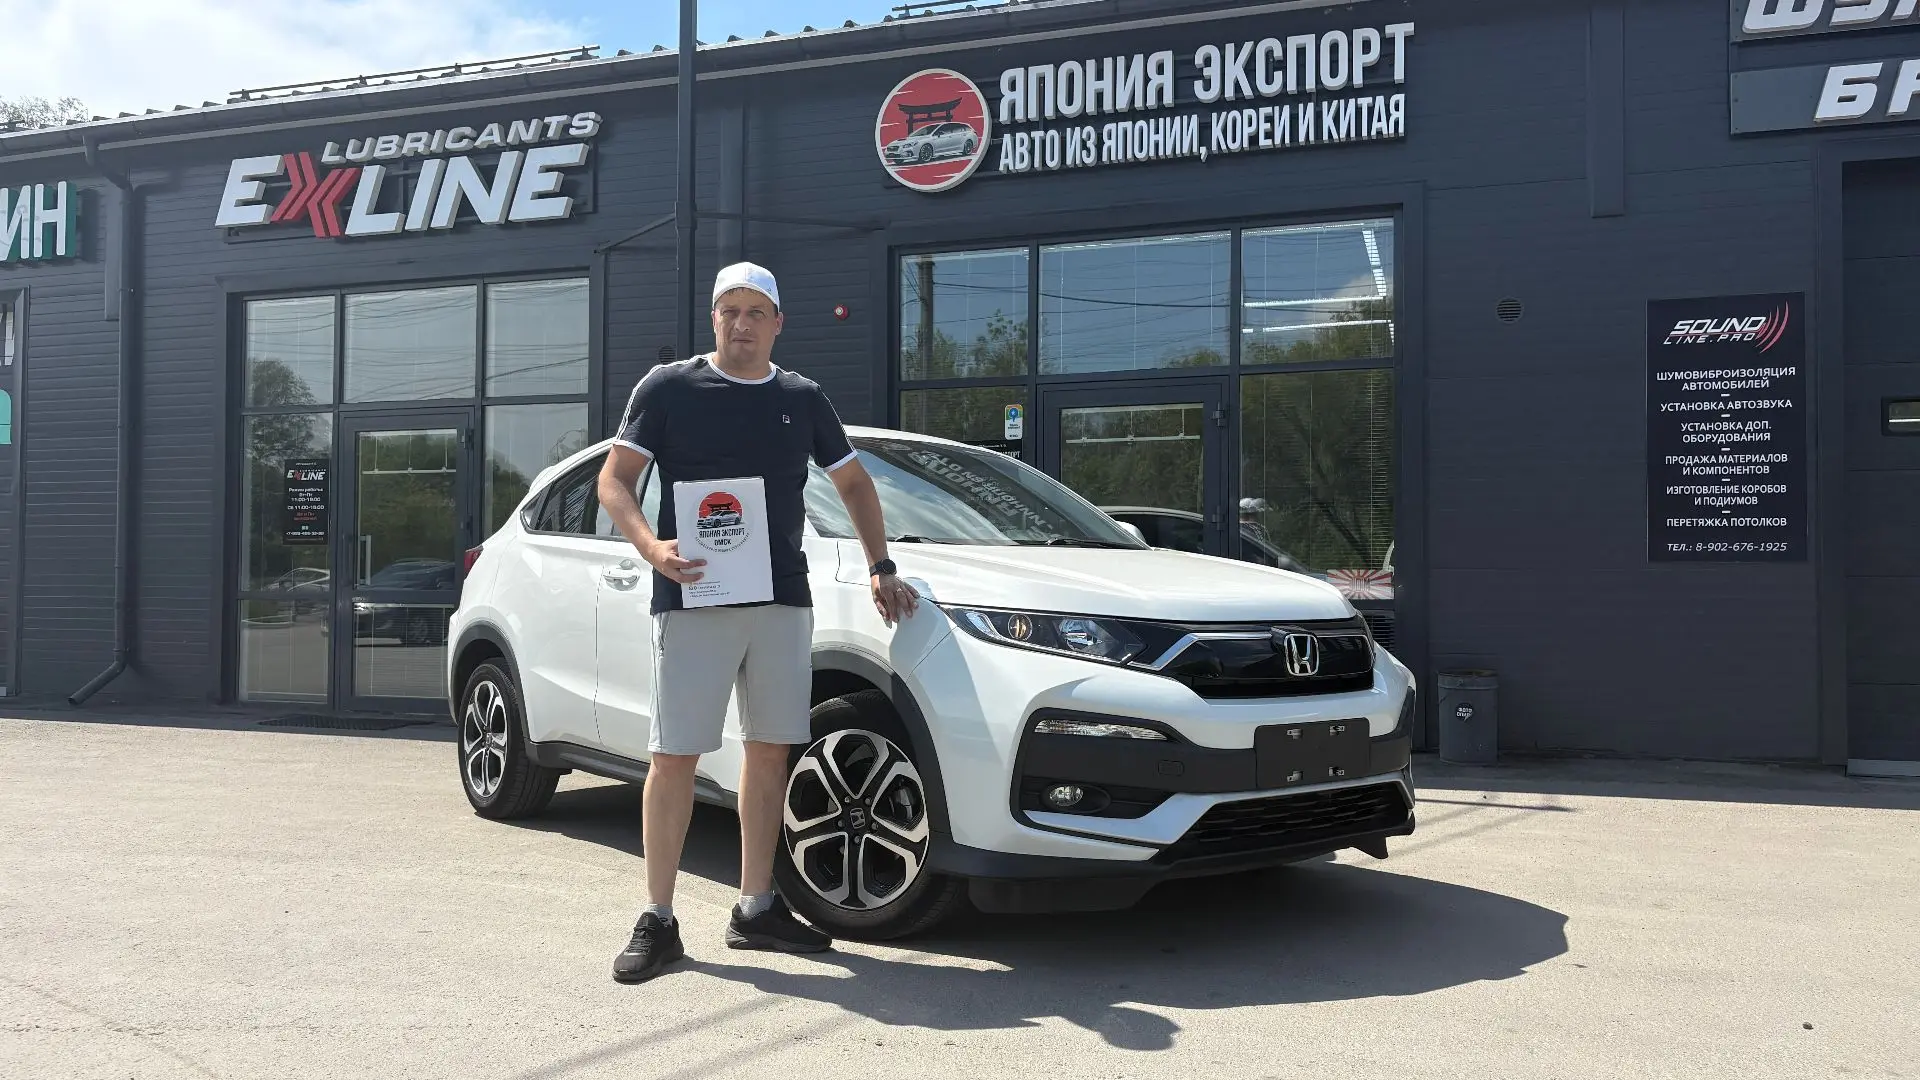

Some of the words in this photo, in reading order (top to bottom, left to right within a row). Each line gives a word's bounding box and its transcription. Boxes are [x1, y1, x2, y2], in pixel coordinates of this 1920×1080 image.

[999, 49, 1175, 124] ЯПОНИЯ
[1193, 21, 1415, 102] ЭКСПОРТ
[320, 111, 603, 164] LUBRICANTS
[999, 129, 1060, 174] АВТО
[1066, 125, 1098, 167] ИЗ
[1102, 115, 1209, 163] ЯПОНИИ,
[1211, 104, 1290, 152] КОРЕИ
[1298, 102, 1316, 144] И
[1320, 92, 1406, 141] КИТАЯ
[214, 142, 590, 238] EXLINE
[1669, 316, 1766, 335] SOUND
[1663, 332, 1756, 345] LINE.PRO
[1656, 366, 1796, 381] ШУМОВИБРОИЗОЛЯЦИЯ
[1681, 377, 1770, 391] АВТОМОБИЛЕЙ
[1660, 402, 1725, 412] УСТАНОВКА
[1726, 399, 1793, 410] АВТОЗВУКА
[1680, 421, 1744, 432] УСТАНОВКА
[1745, 420, 1772, 432] ДОП.
[1682, 432, 1771, 444] ОБОРУДОВАНИЯ
[1665, 455, 1717, 466] ПРОДАЖА
[1718, 453, 1788, 464] МАТЕРИАЛОВ
[1682, 467, 1691, 476] И
[1692, 465, 1770, 475] КОМПОНЕНТОВ
[1666, 485, 1740, 495] ИЗГОТОВЛЕНИЕ
[1741, 484, 1787, 494] КОРОБОВ
[1694, 497, 1702, 506] И
[1703, 496, 1758, 507] ПОДИУМОВ
[1666, 518, 1729, 527] ПЕРЕТЯЖКА
[1730, 517, 1787, 527] ПОТОЛКОВ
[1667, 543, 1693, 552] ТЕЛ.:
[1695, 542, 1788, 552] 8-902-676-1925
